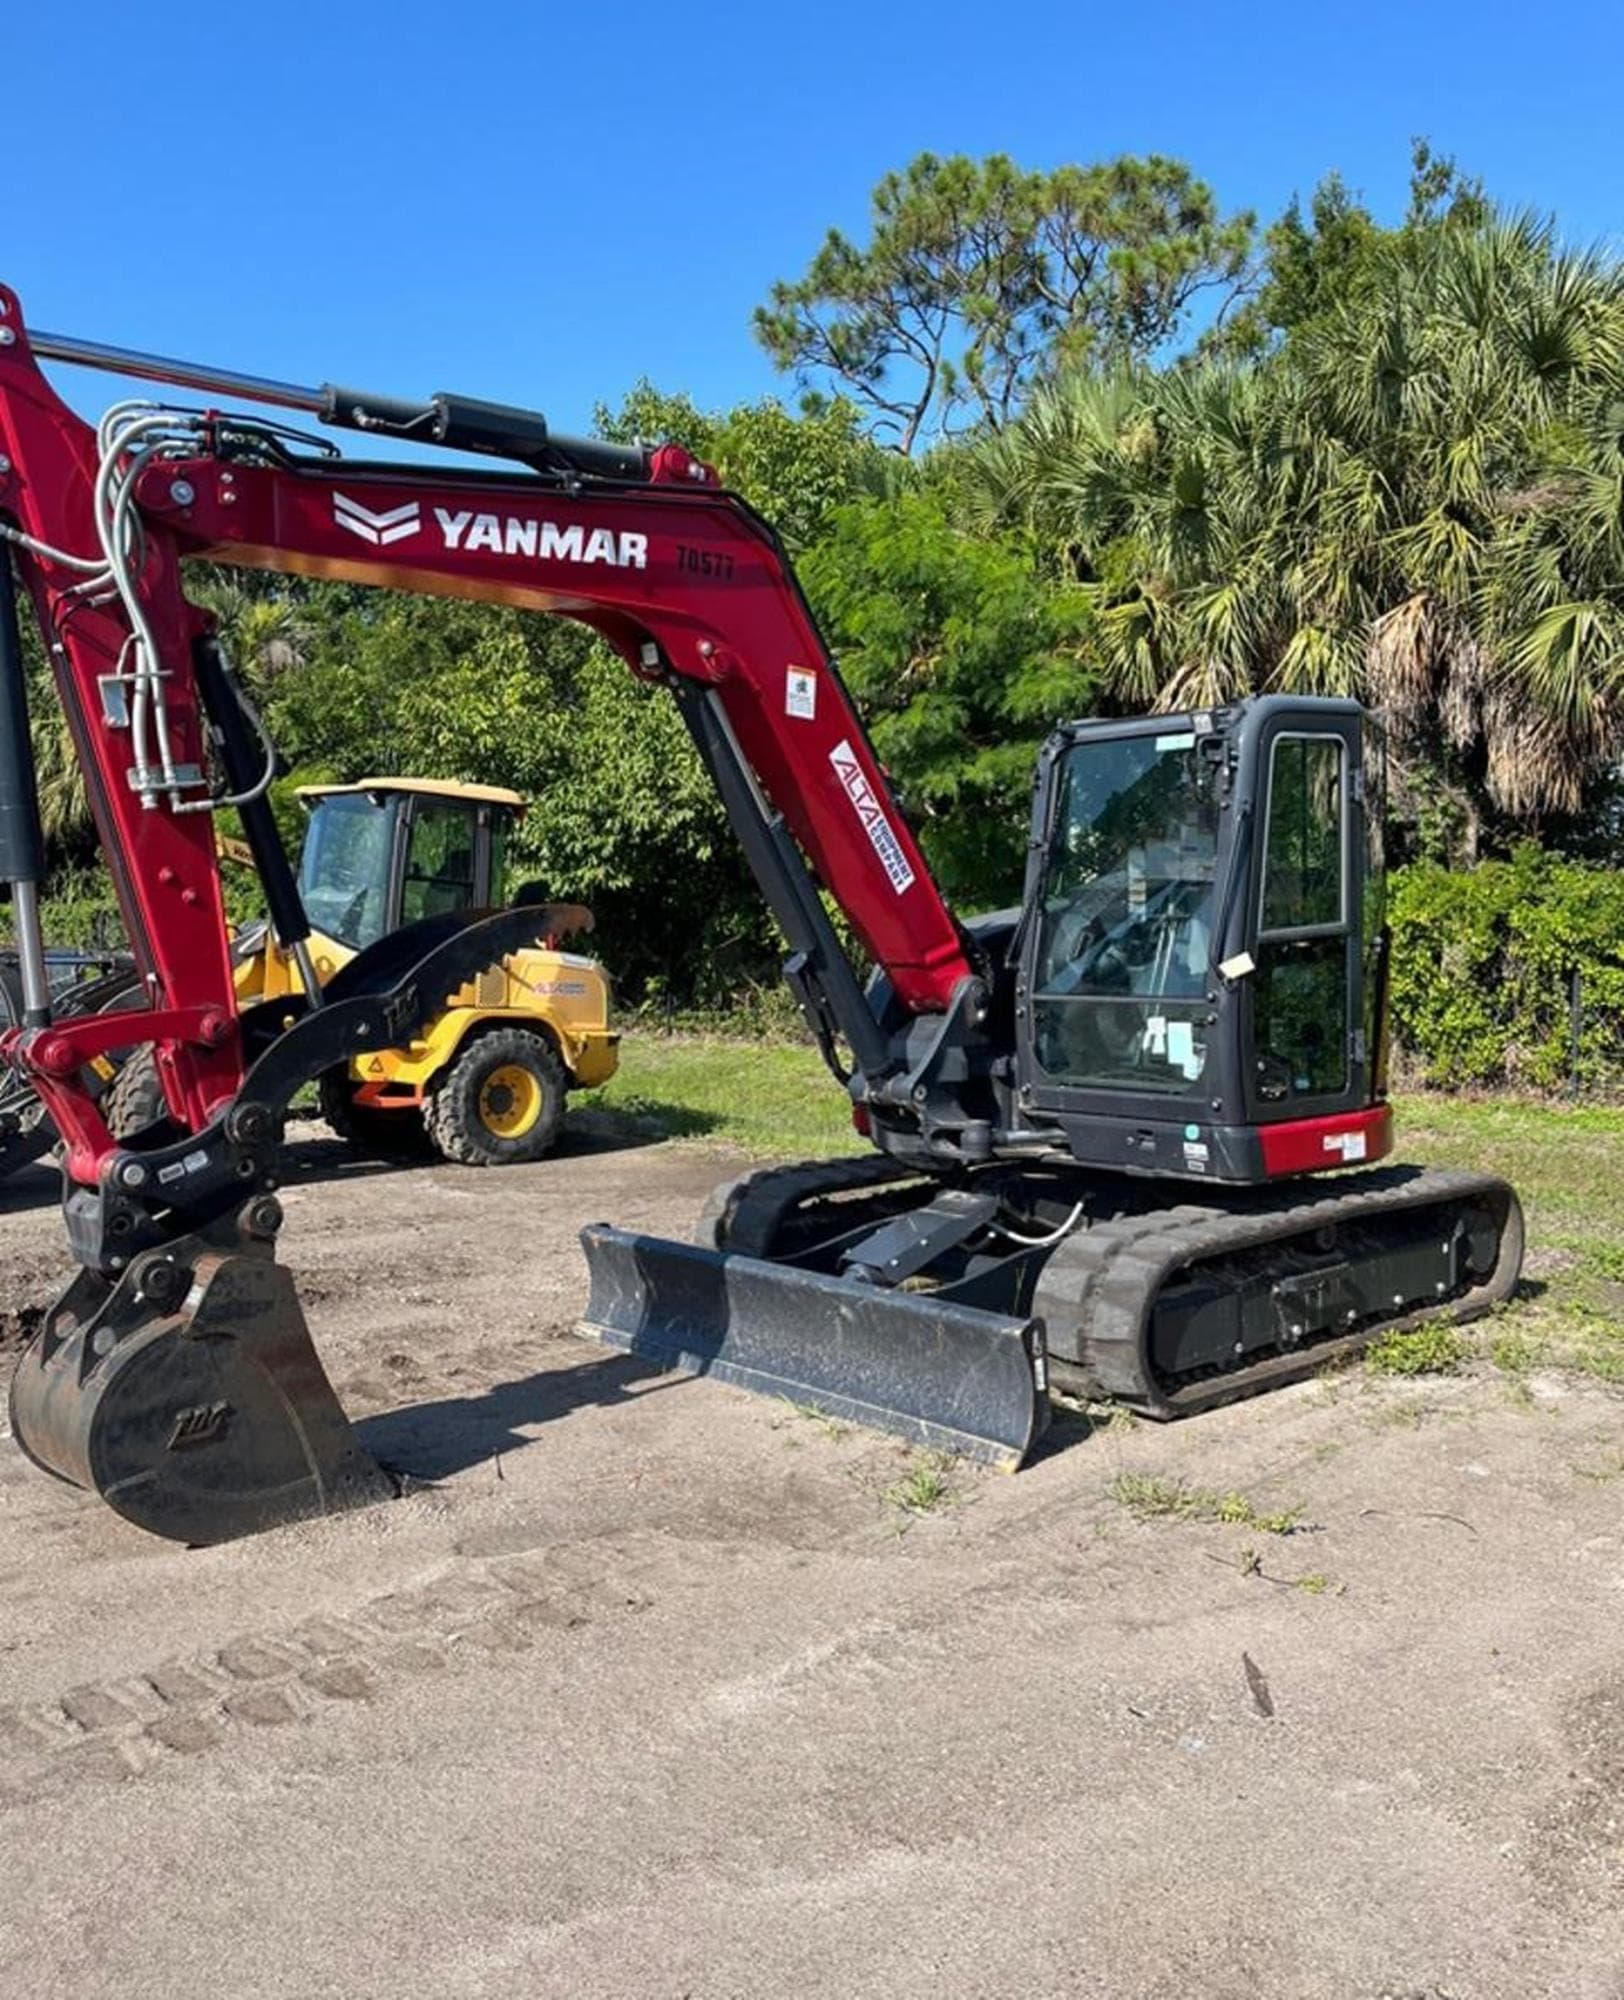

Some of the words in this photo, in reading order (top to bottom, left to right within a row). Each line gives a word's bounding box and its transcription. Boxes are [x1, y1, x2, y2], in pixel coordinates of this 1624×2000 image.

[434, 508, 648, 569] YANMAR
[835, 760, 880, 825] ALTA
[869, 828, 903, 884] COMPANY
